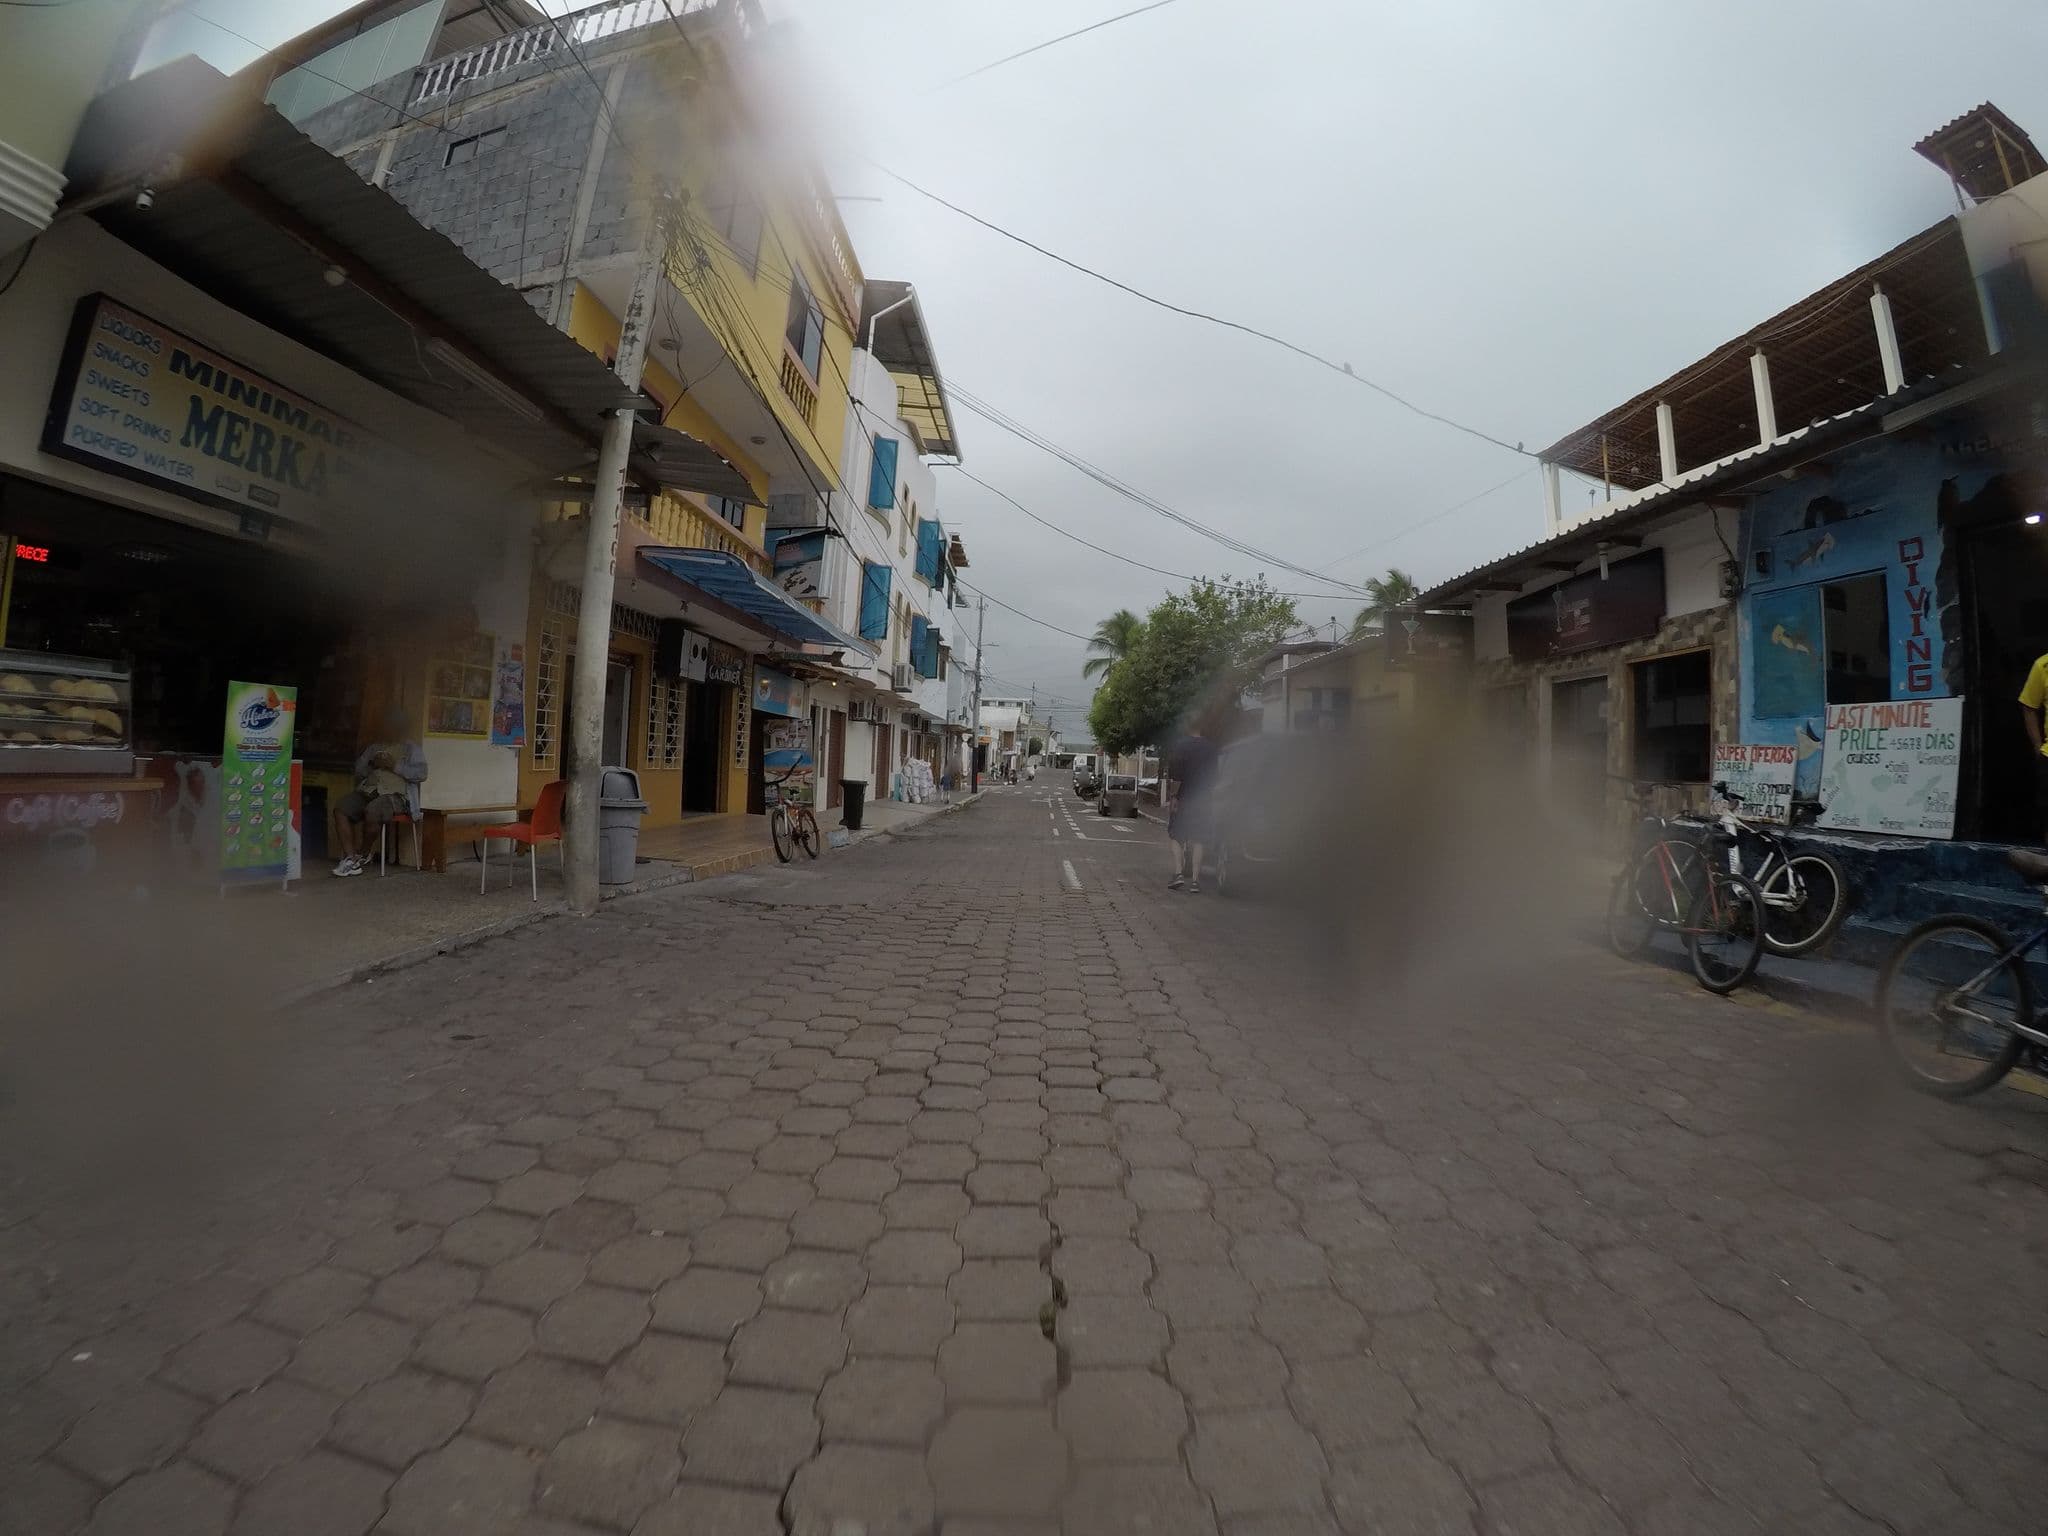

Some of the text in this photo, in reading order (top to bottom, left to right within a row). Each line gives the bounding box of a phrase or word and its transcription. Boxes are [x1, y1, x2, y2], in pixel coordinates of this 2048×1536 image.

[101, 315, 162, 354] LIQUORS
[93, 342, 151, 378] SNACKS
[85, 369, 151, 406] SWEETS
[79, 397, 172, 444] SOFT DRINKS
[71, 423, 195, 480] PURIFIED WATER
[1898, 535, 1933, 693] DIVING
[1826, 701, 1933, 730] LAST MINUTE
[1716, 745, 1795, 765] SUPER OFERTAS
[1839, 728, 1889, 751] PRICE
[1715, 761, 1754, 773] ISABELA
[1846, 752, 1881, 765] CRUISES
[1756, 783, 1793, 795] SEYMOUR
